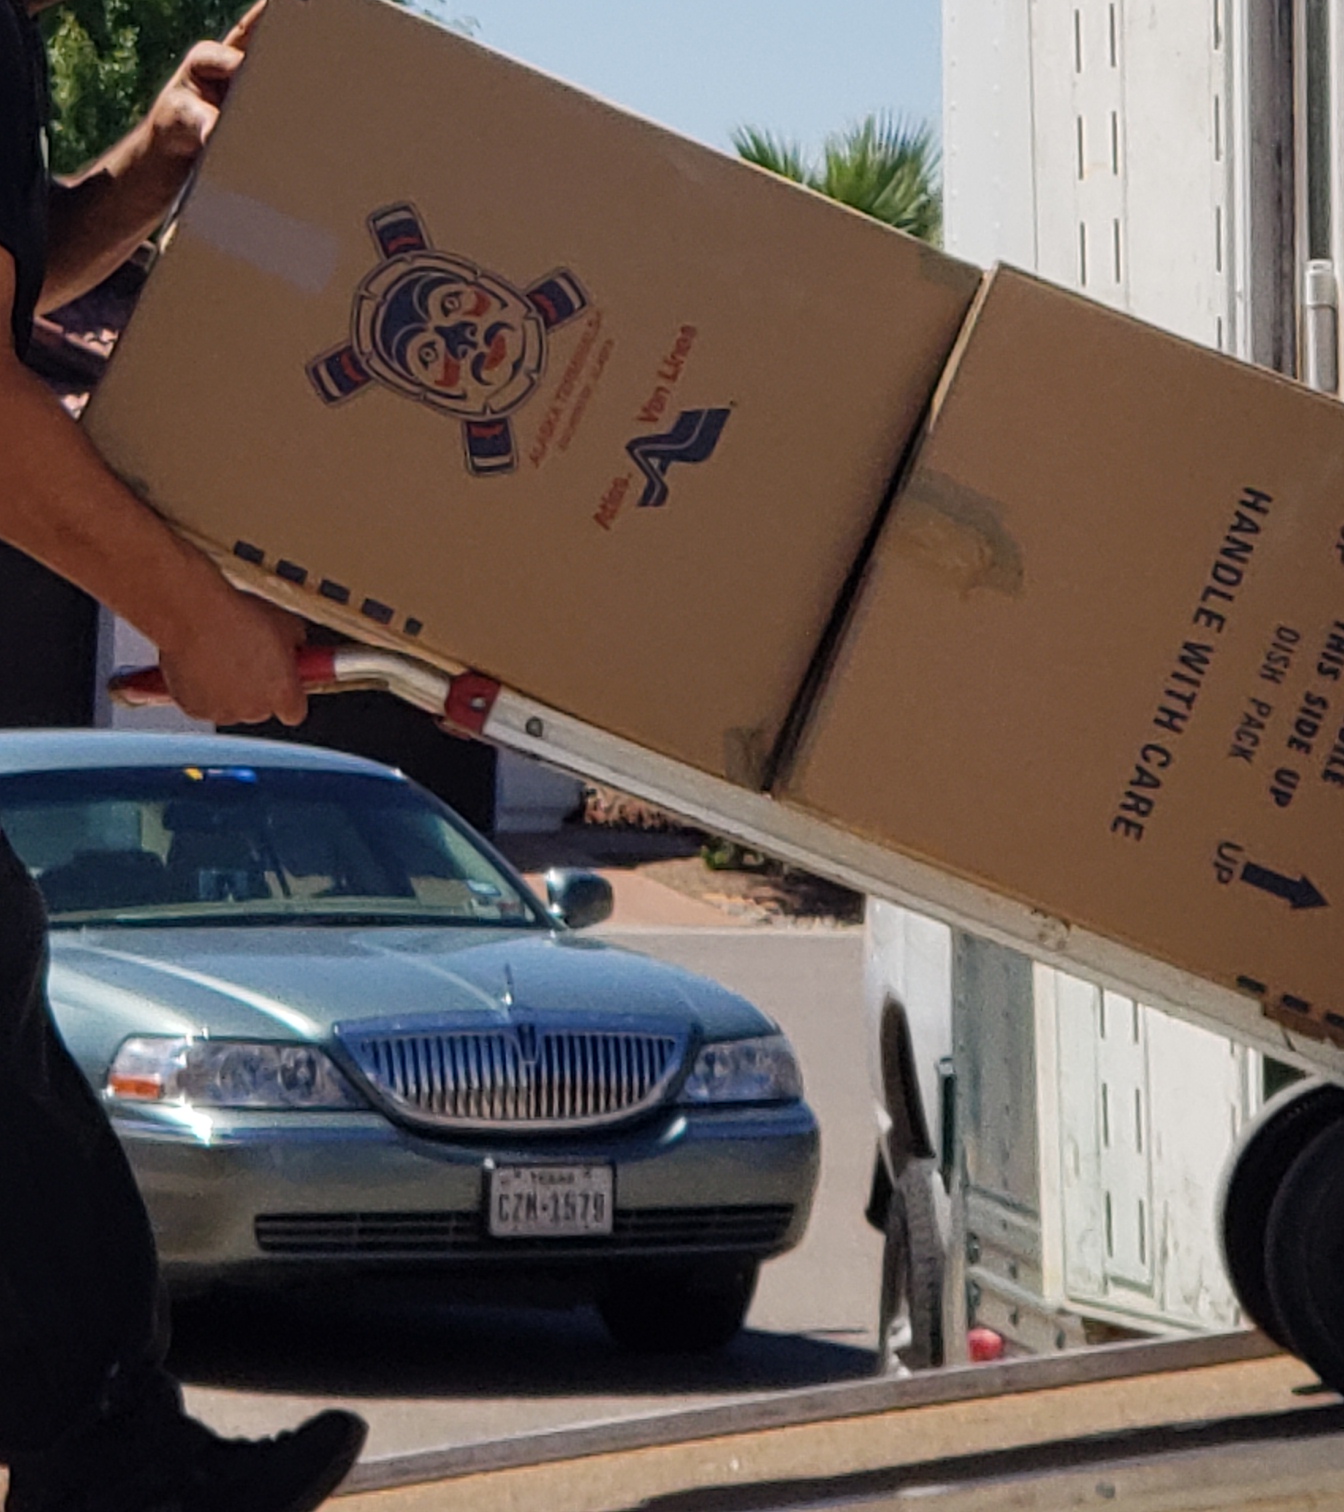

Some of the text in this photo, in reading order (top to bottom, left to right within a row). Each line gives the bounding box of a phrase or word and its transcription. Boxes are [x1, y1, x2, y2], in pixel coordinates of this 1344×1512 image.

[636, 324, 698, 423] Van Lines
[1109, 486, 1274, 842] HANDLE WITH CARE
[1227, 625, 1301, 765] DISH PACK
[1287, 691, 1330, 755] SIDE
[1268, 765, 1301, 809] UP
[1212, 839, 1244, 886] UP
